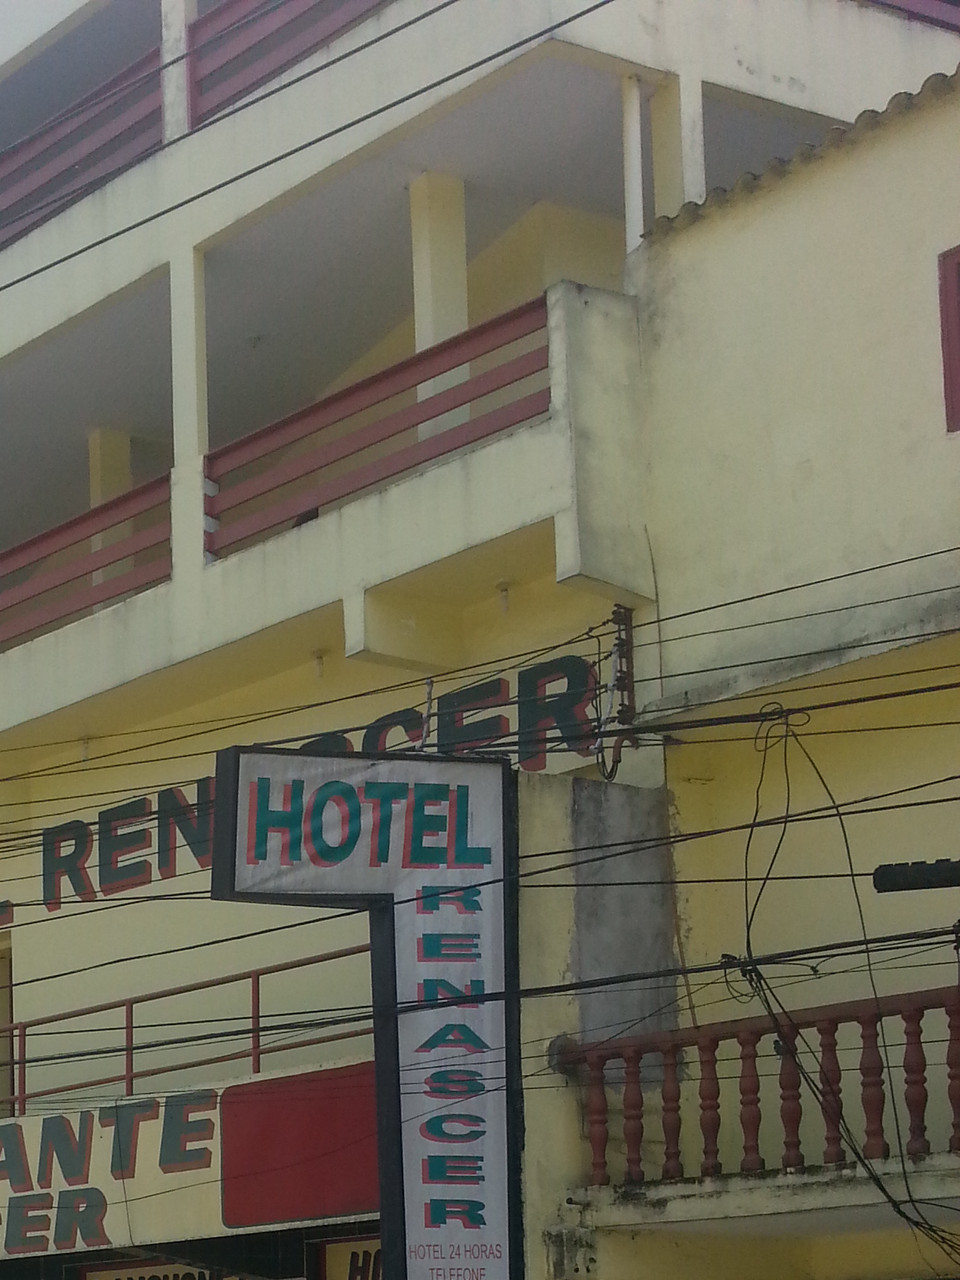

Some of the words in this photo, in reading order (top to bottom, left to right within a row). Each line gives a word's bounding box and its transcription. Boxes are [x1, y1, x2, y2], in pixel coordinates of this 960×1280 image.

[246, 777, 492, 869] HOTEL
[414, 885, 491, 1231] RENASCER
[409, 1244, 446, 1260] HOTEL
[449, 1244, 461, 1259] 24
[463, 1243, 503, 1260] HORAS
